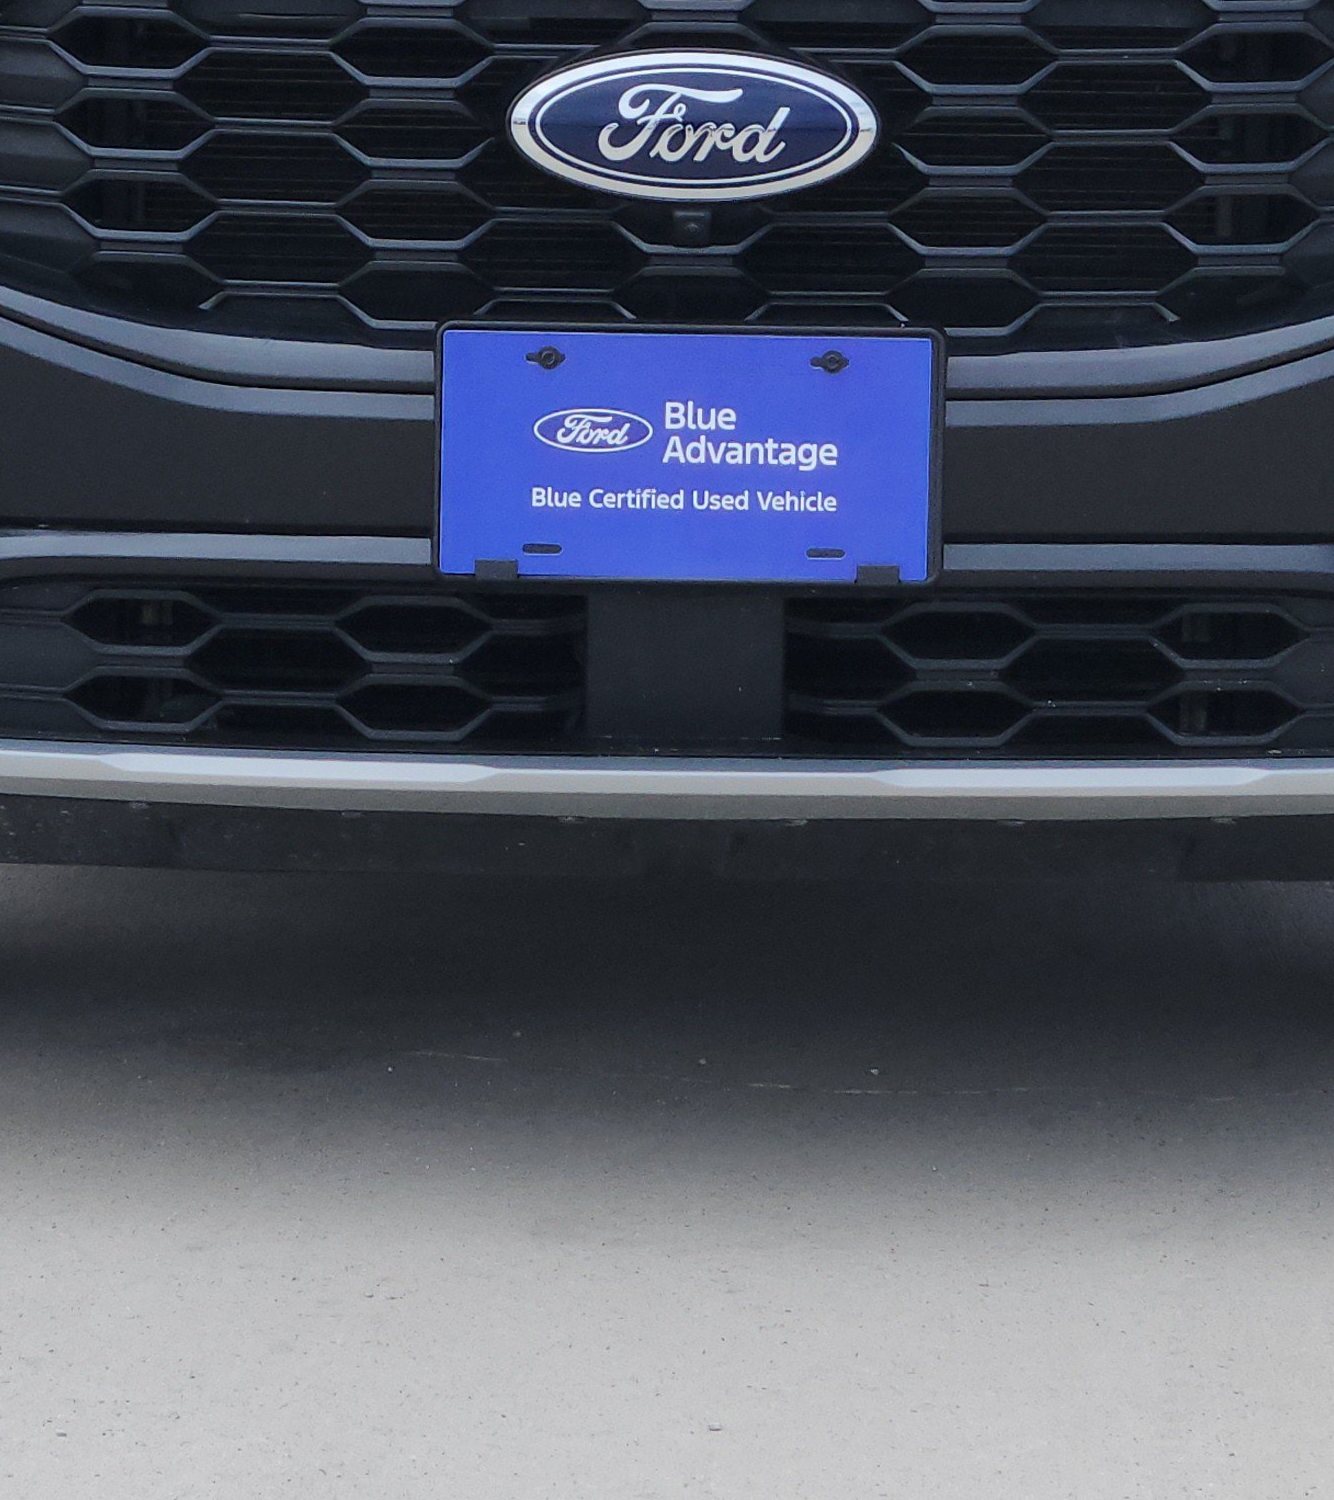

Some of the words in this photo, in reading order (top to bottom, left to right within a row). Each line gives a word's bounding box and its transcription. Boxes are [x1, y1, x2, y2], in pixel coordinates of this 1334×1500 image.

[598, 82, 791, 163] Ford
[556, 413, 632, 446] Ford
[664, 400, 737, 431] Blue
[662, 435, 838, 471] Advantage
[531, 487, 581, 508] Blue
[588, 487, 684, 510] Certified
[692, 489, 749, 511] Used
[757, 489, 837, 512] Vehicle
